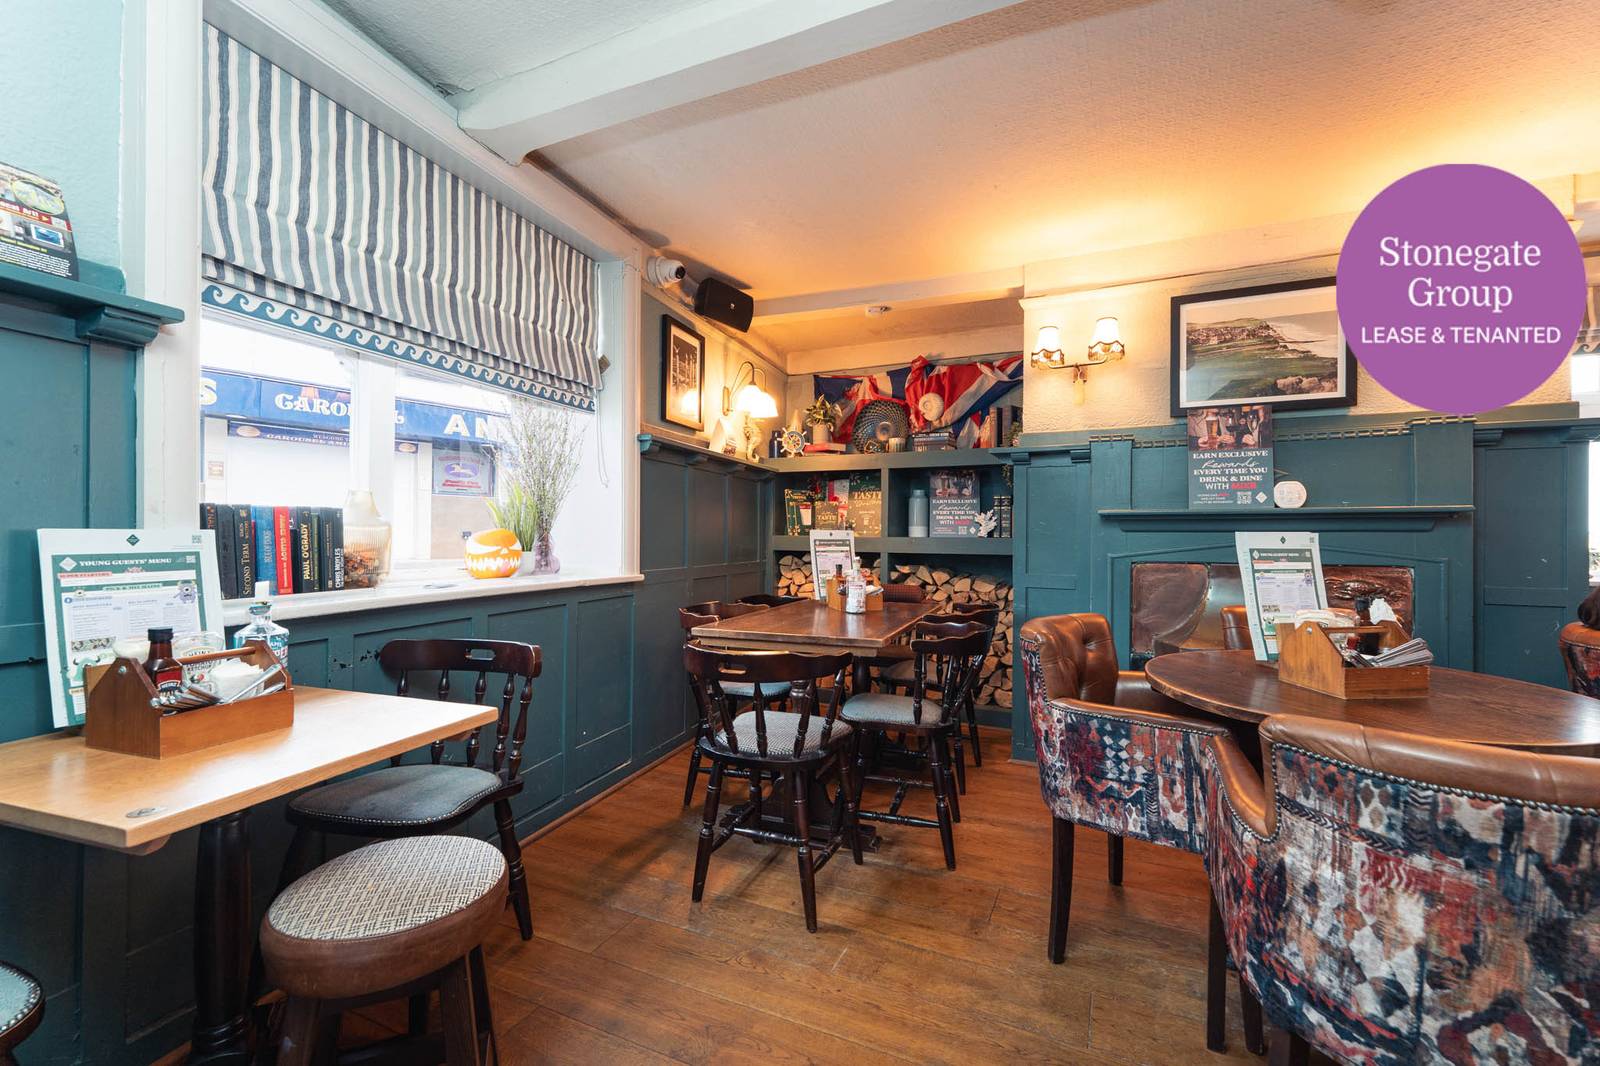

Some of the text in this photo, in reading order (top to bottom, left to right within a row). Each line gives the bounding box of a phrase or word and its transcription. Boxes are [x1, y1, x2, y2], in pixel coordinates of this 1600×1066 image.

[1202, 457, 1259, 468] Rewards
[241, 544, 251, 594] SECOND TERM
[301, 523, 311, 580] PAUL O'GRADY
